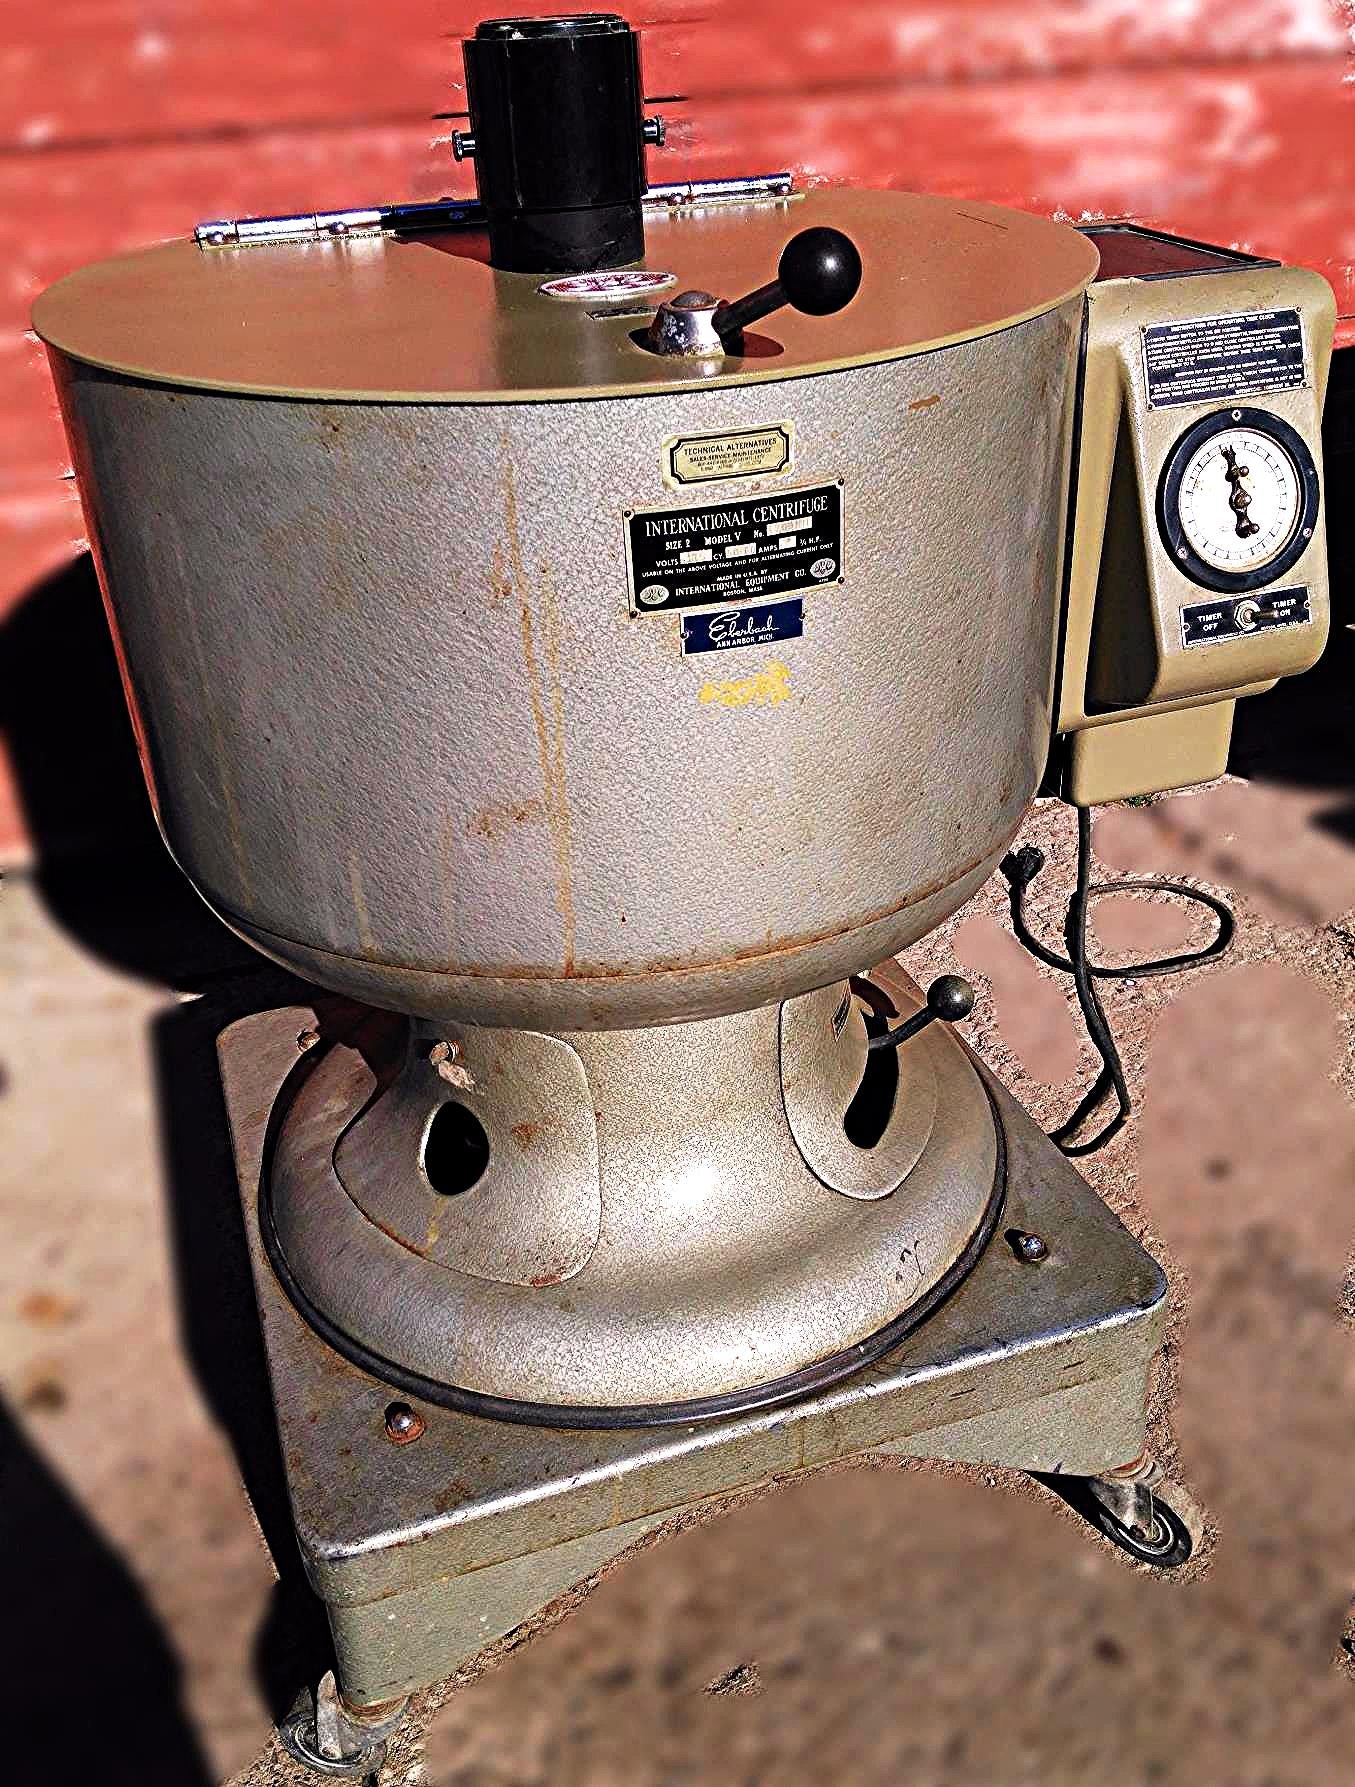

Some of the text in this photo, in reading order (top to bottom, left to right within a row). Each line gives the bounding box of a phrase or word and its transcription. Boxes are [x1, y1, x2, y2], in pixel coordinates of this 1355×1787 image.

[684, 438, 777, 456] TECHNICAL ALTERNATIVES
[645, 510, 749, 537] INTERNATIONAL
[752, 495, 828, 523] CENTRIFUGE
[665, 540, 682, 550] SIZE
[685, 538, 691, 548] 2
[704, 534, 732, 546] MODEL
[734, 531, 741, 541] V
[641, 570, 662, 578] USABLE
[687, 564, 706, 572] ABOVE
[708, 561, 732, 570] VOLTAGE
[761, 550, 795, 562] ALTERNATING
[796, 545, 818, 555] CURRENT
[819, 542, 834, 550] ONLY
[655, 558, 679, 568] VOLTS
[758, 544, 778, 554] AMPS
[675, 581, 740, 597] INTERNATIONAL
[745, 571, 790, 587] EQUIPMENT
[794, 568, 807, 578] CO.
[716, 574, 732, 582] MADE
[1271, 598, 1297, 609] TIMER
[1279, 608, 1291, 617] ON
[708, 611, 780, 642] Eberbach
[1197, 612, 1223, 623] TIMER
[1202, 622, 1219, 632] OFF
[716, 639, 731, 649] ANN
[758, 633, 774, 642] MICH.
